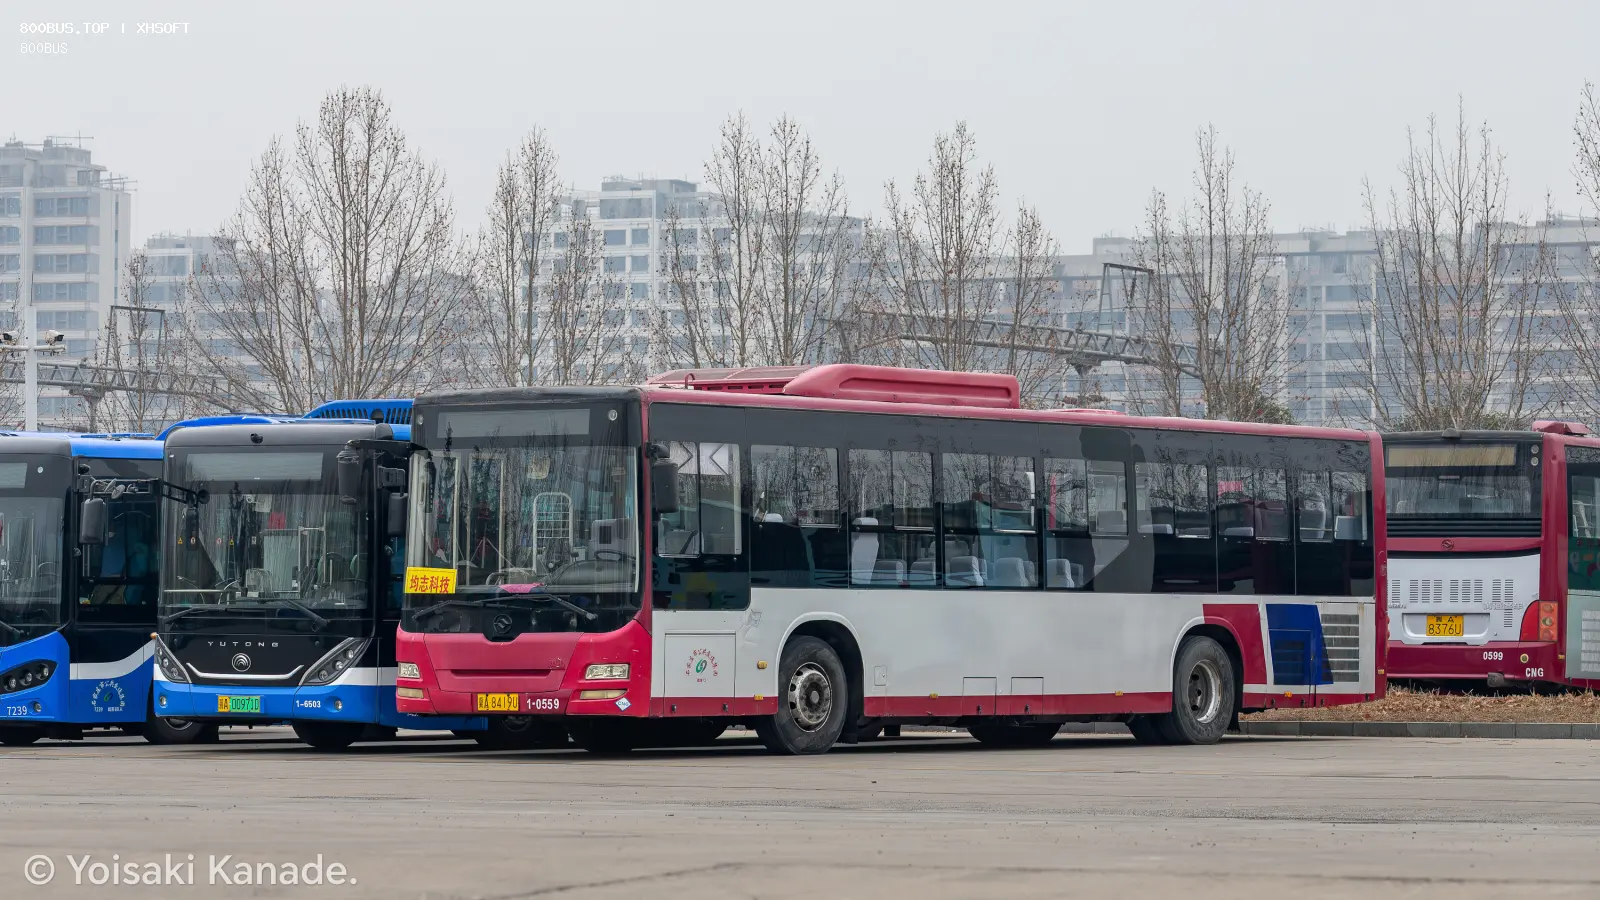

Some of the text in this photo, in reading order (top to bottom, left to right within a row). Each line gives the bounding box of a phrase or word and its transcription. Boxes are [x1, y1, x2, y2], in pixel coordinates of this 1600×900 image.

[410, 575, 451, 594] 均志科技
[1428, 623, 1462, 635] 8376U
[1482, 651, 1504, 661] 0599
[1525, 667, 1544, 677] CNG
[295, 700, 321, 708] 1-6503
[526, 698, 560, 710] 1-0559
[6, 705, 28, 716] 7239
